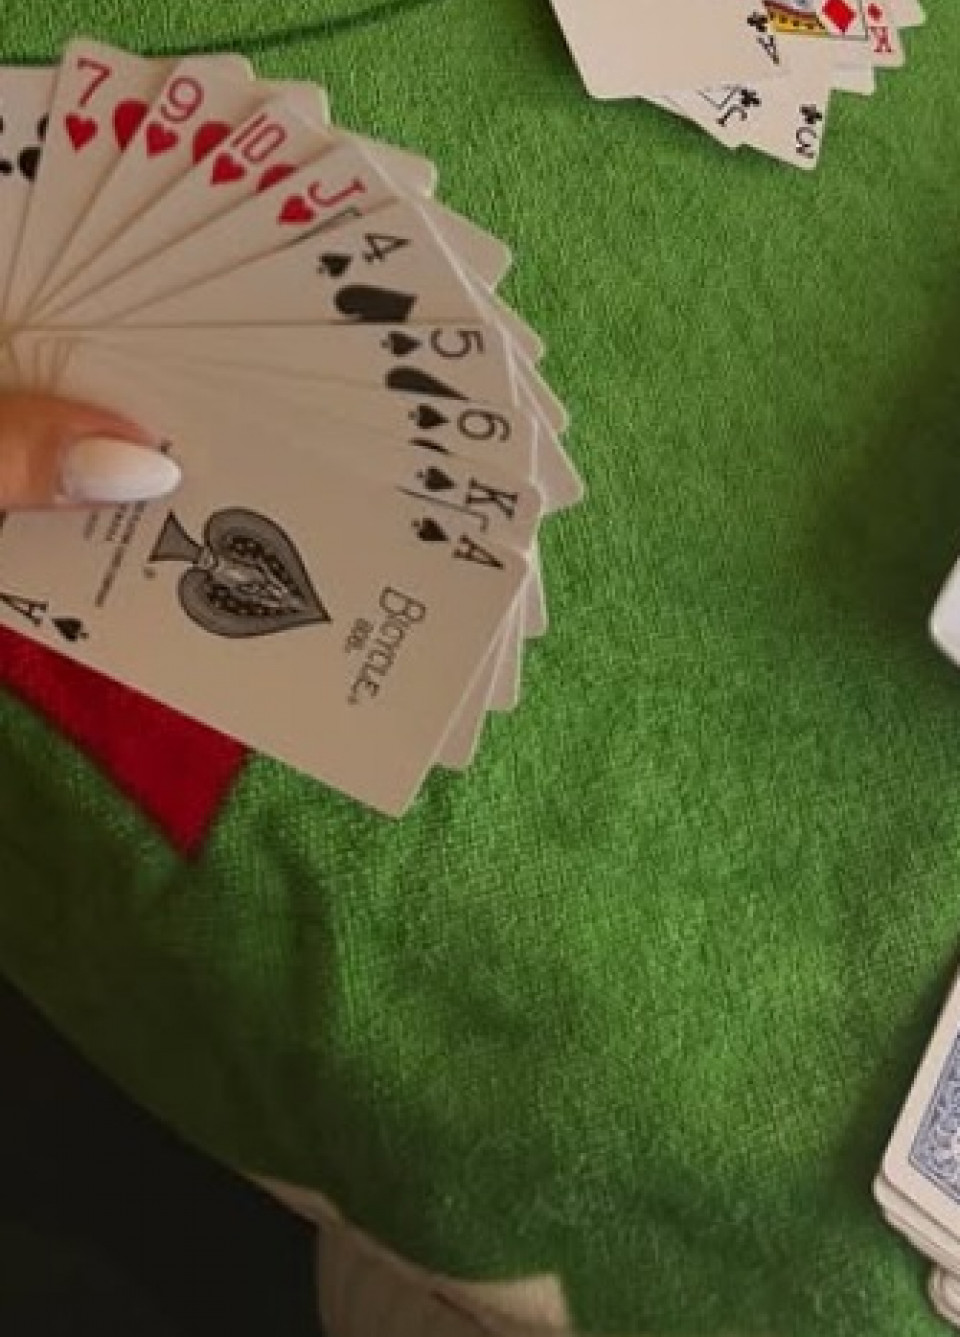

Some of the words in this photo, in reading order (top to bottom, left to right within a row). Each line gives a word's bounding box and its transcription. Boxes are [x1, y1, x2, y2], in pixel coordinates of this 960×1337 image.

[756, 35, 780, 65] A
[869, 26, 893, 54] K
[77, 57, 113, 107] 7
[160, 77, 204, 122] 9
[230, 113, 287, 163] 10
[307, 177, 367, 208] J
[362, 233, 412, 264] 4
[430, 328, 485, 360] 5
[457, 408, 512, 443] 6
[466, 476, 519, 520] K
[453, 533, 505, 570] A
[0, 592, 48, 627] A
